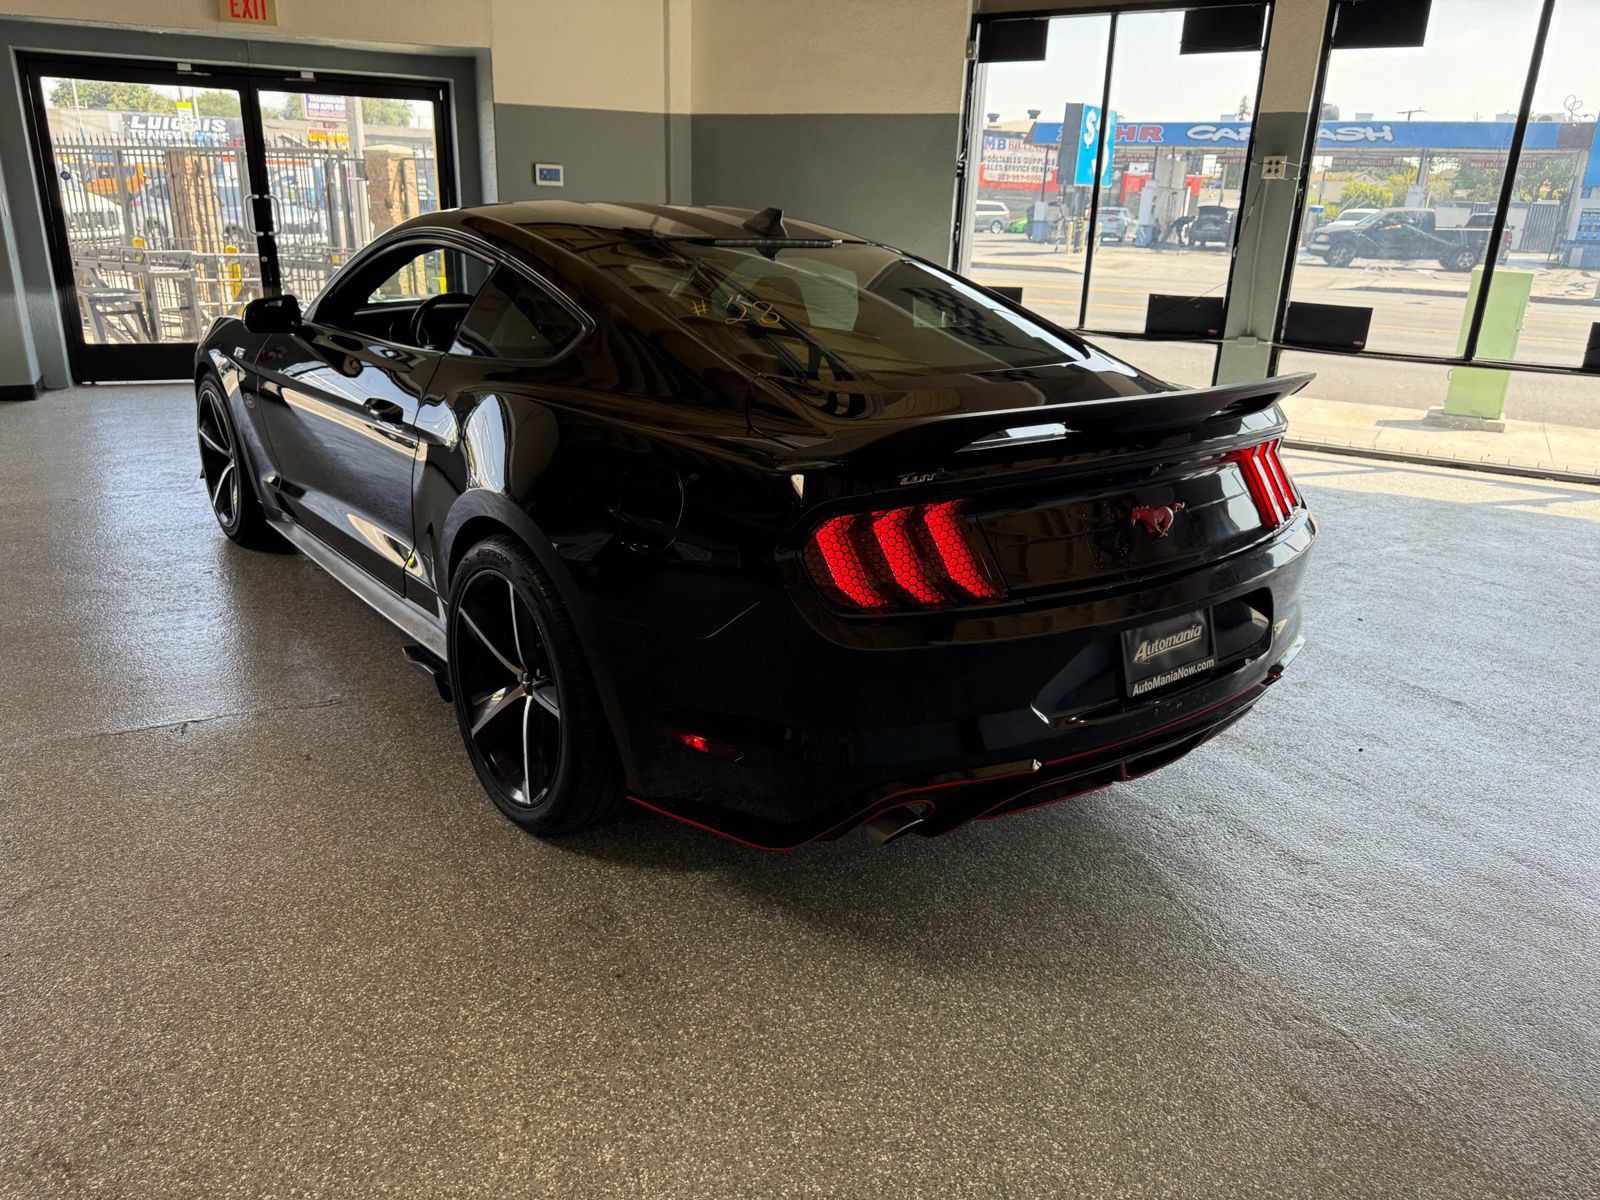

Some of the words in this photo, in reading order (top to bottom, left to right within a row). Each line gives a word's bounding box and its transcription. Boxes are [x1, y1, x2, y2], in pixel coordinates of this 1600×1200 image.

[229, 0, 267, 21] EXIT
[1318, 124, 1394, 142] ASH
[1133, 625, 1202, 661] Automania
[1132, 659, 1215, 696] AutoManiaNow.com
